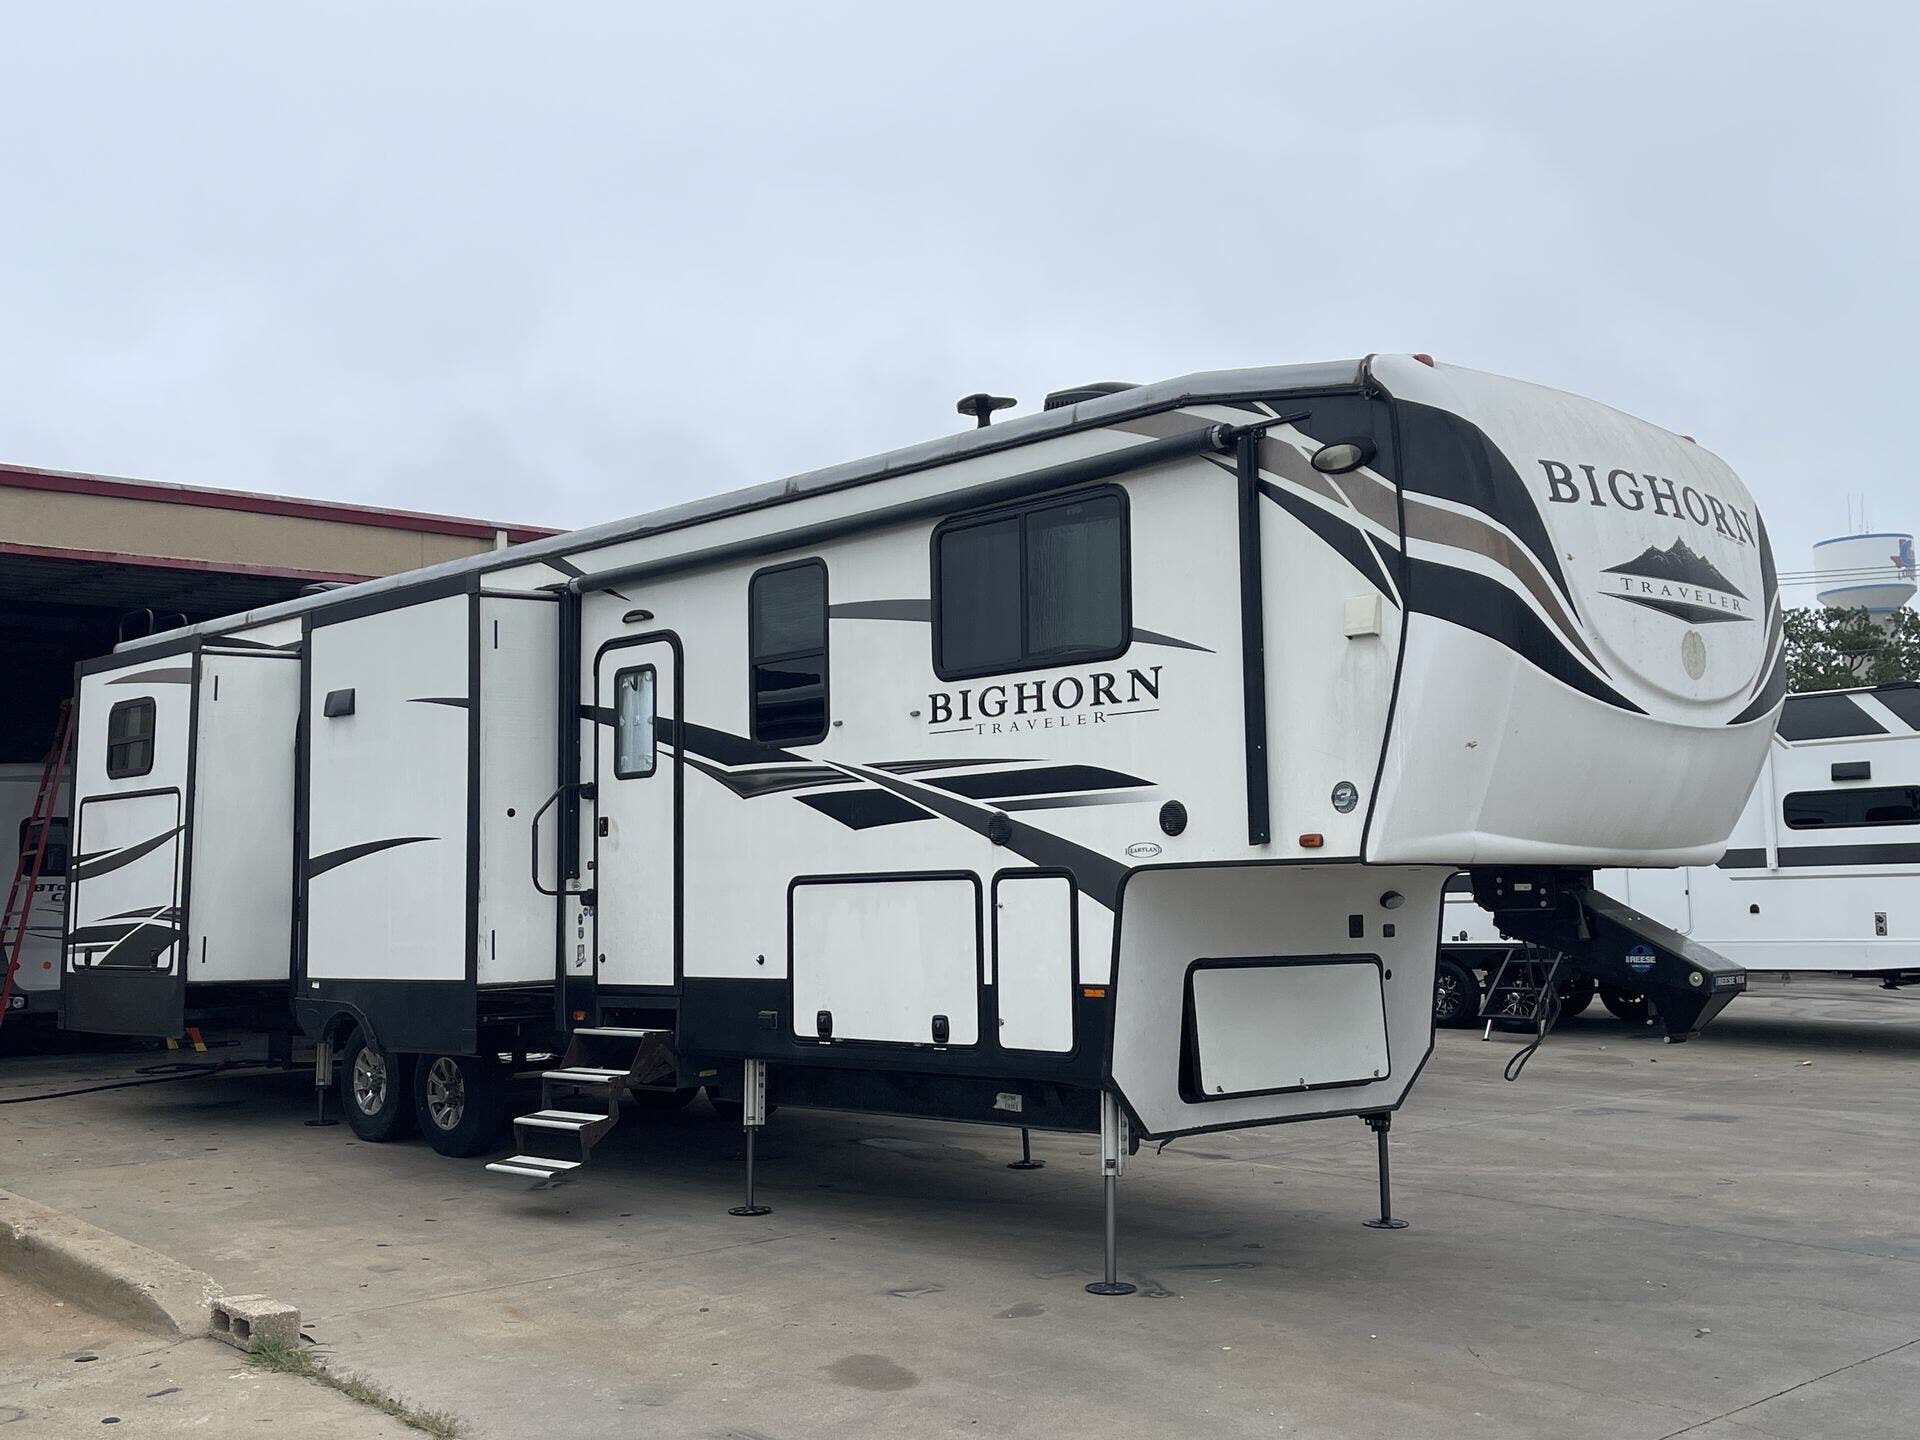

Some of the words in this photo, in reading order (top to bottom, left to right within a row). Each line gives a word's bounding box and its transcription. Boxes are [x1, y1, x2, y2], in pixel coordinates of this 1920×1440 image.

[1538, 459, 1755, 548] BIGHORN
[1620, 577, 1742, 611] TRAVELER
[928, 666, 1163, 724] BIGHORN
[975, 711, 1107, 735] TRAVELER
[1630, 955, 1657, 964] REESE
[1715, 976, 1736, 986] REESE
